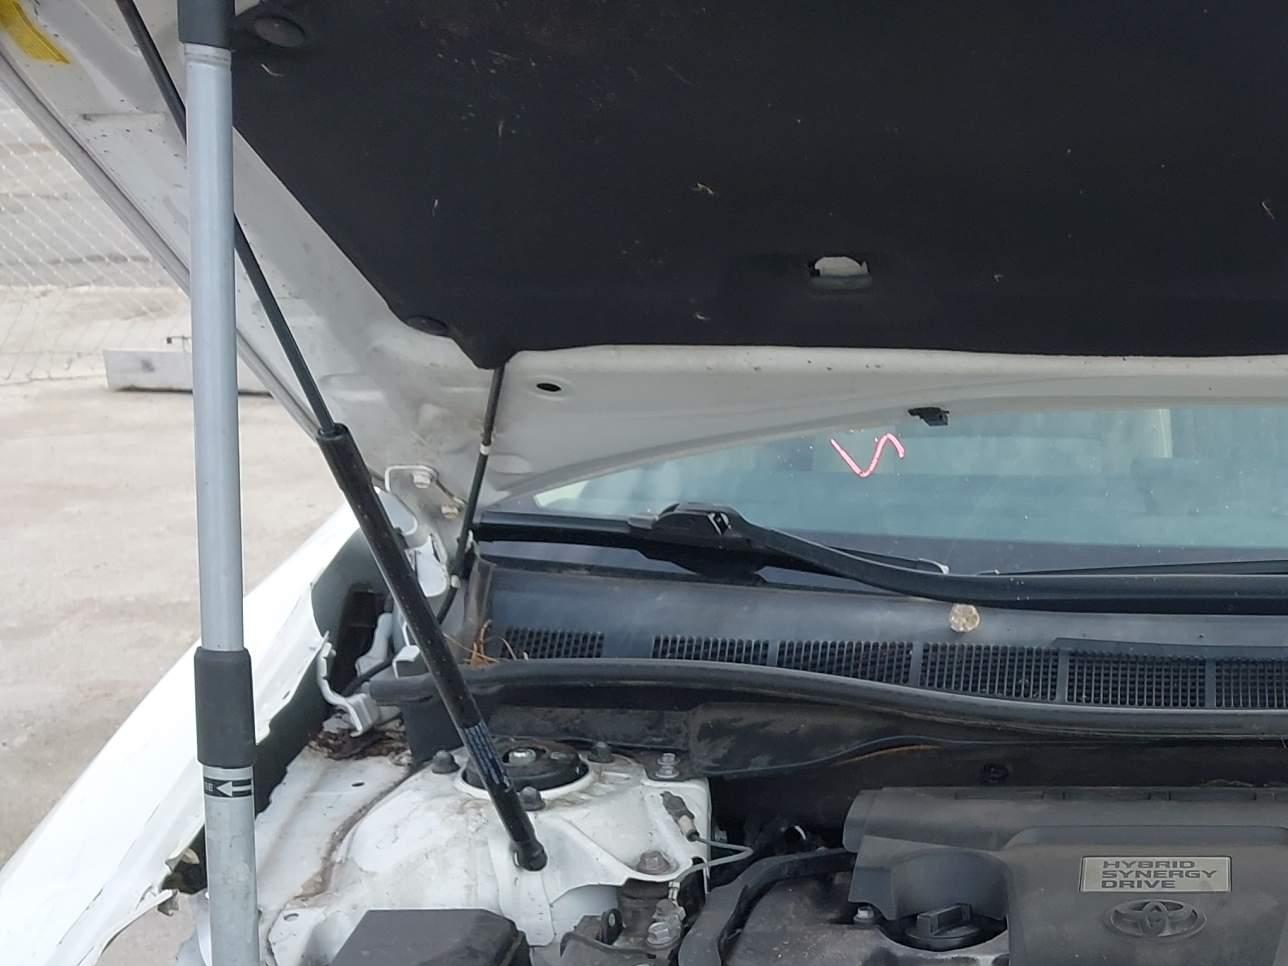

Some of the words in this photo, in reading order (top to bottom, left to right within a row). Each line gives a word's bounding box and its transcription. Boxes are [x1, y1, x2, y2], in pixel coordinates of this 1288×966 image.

[1103, 860, 1196, 869] HYBRID
[1101, 870, 1217, 879] SYNERGY
[1101, 879, 1177, 889] DRIVE
